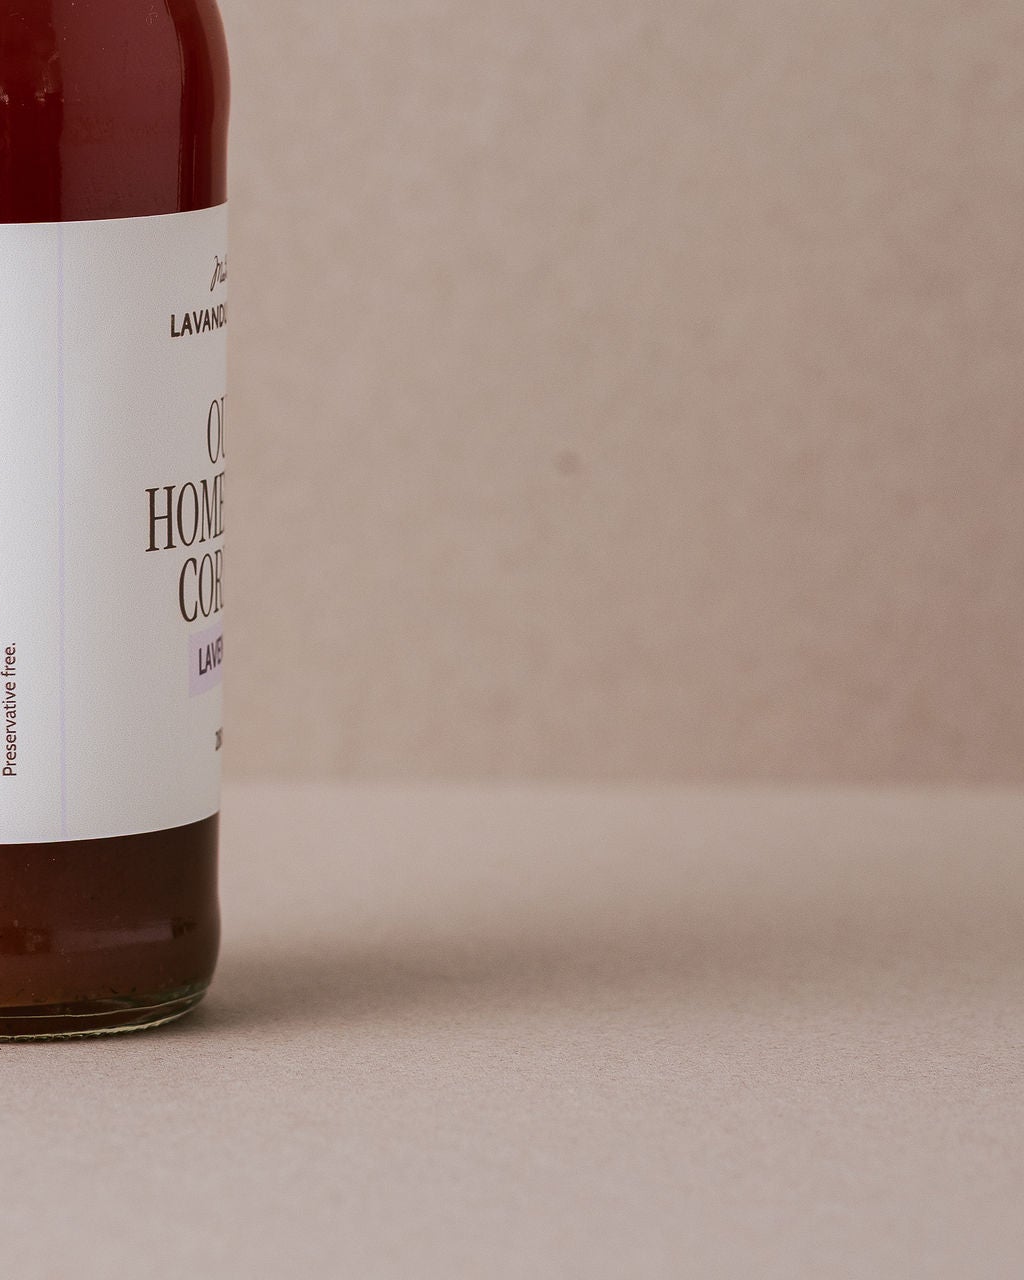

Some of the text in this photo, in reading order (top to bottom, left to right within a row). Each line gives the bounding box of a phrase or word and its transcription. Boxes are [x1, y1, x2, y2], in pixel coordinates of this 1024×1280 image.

[170, 302, 227, 338] LAVAND
[178, 545, 225, 623] COR
[198, 634, 224, 676] LAVE
[0, 642, 18, 777] Preservative free.
